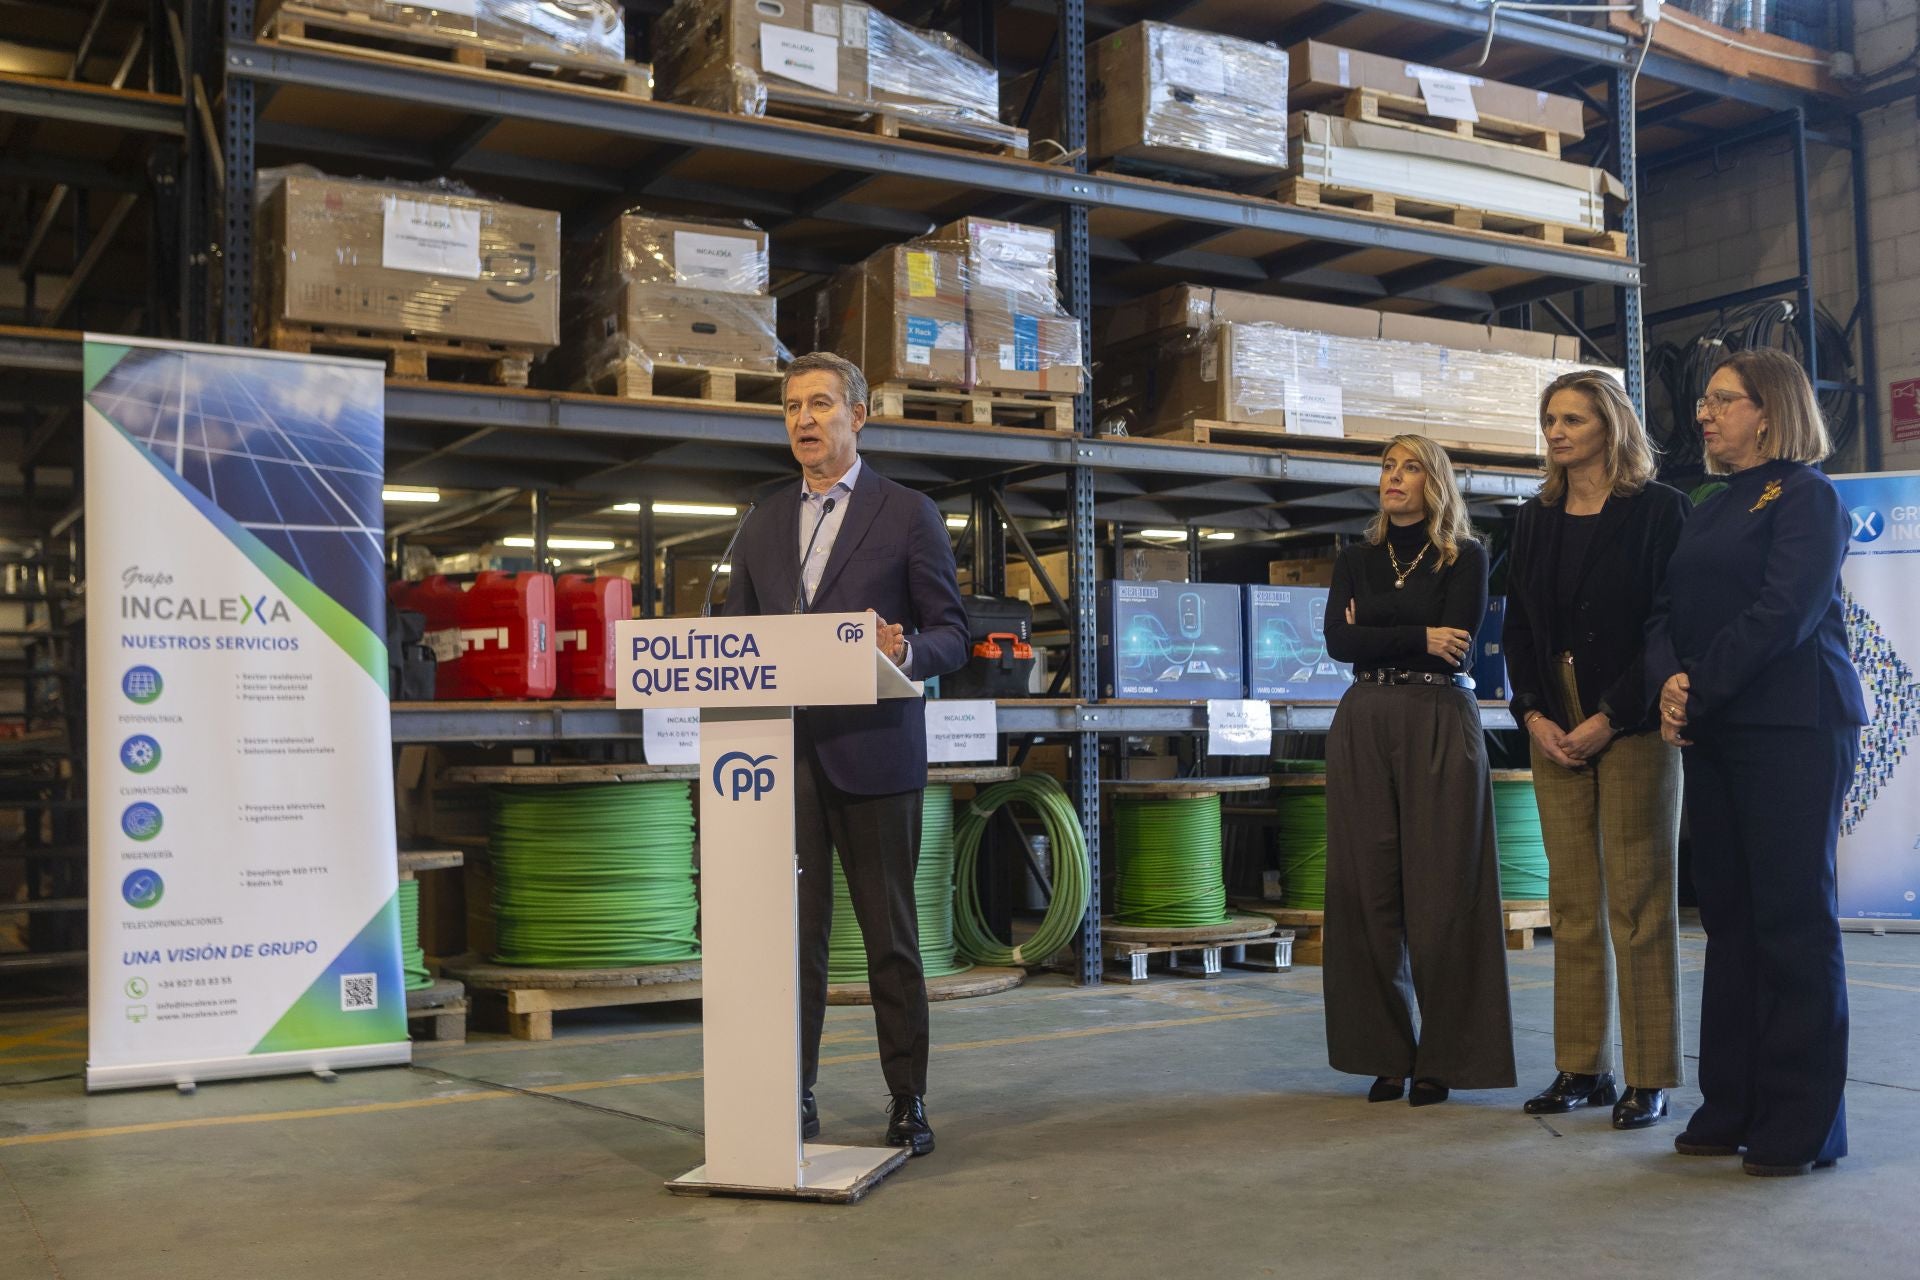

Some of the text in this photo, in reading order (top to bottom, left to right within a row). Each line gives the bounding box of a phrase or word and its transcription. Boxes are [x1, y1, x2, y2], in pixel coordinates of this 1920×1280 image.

[121, 565, 174, 588] Grupo
[121, 594, 291, 625] INCALEXA
[122, 634, 299, 651] NUESTROS SERVICIOS
[632, 628, 760, 660] POLÍTICA
[632, 666, 777, 696] QUE SIRVE
[122, 916, 224, 930] TELECOMUNICACIONES
[123, 940, 318, 966] UNA VISIÓN DE GRUPO
